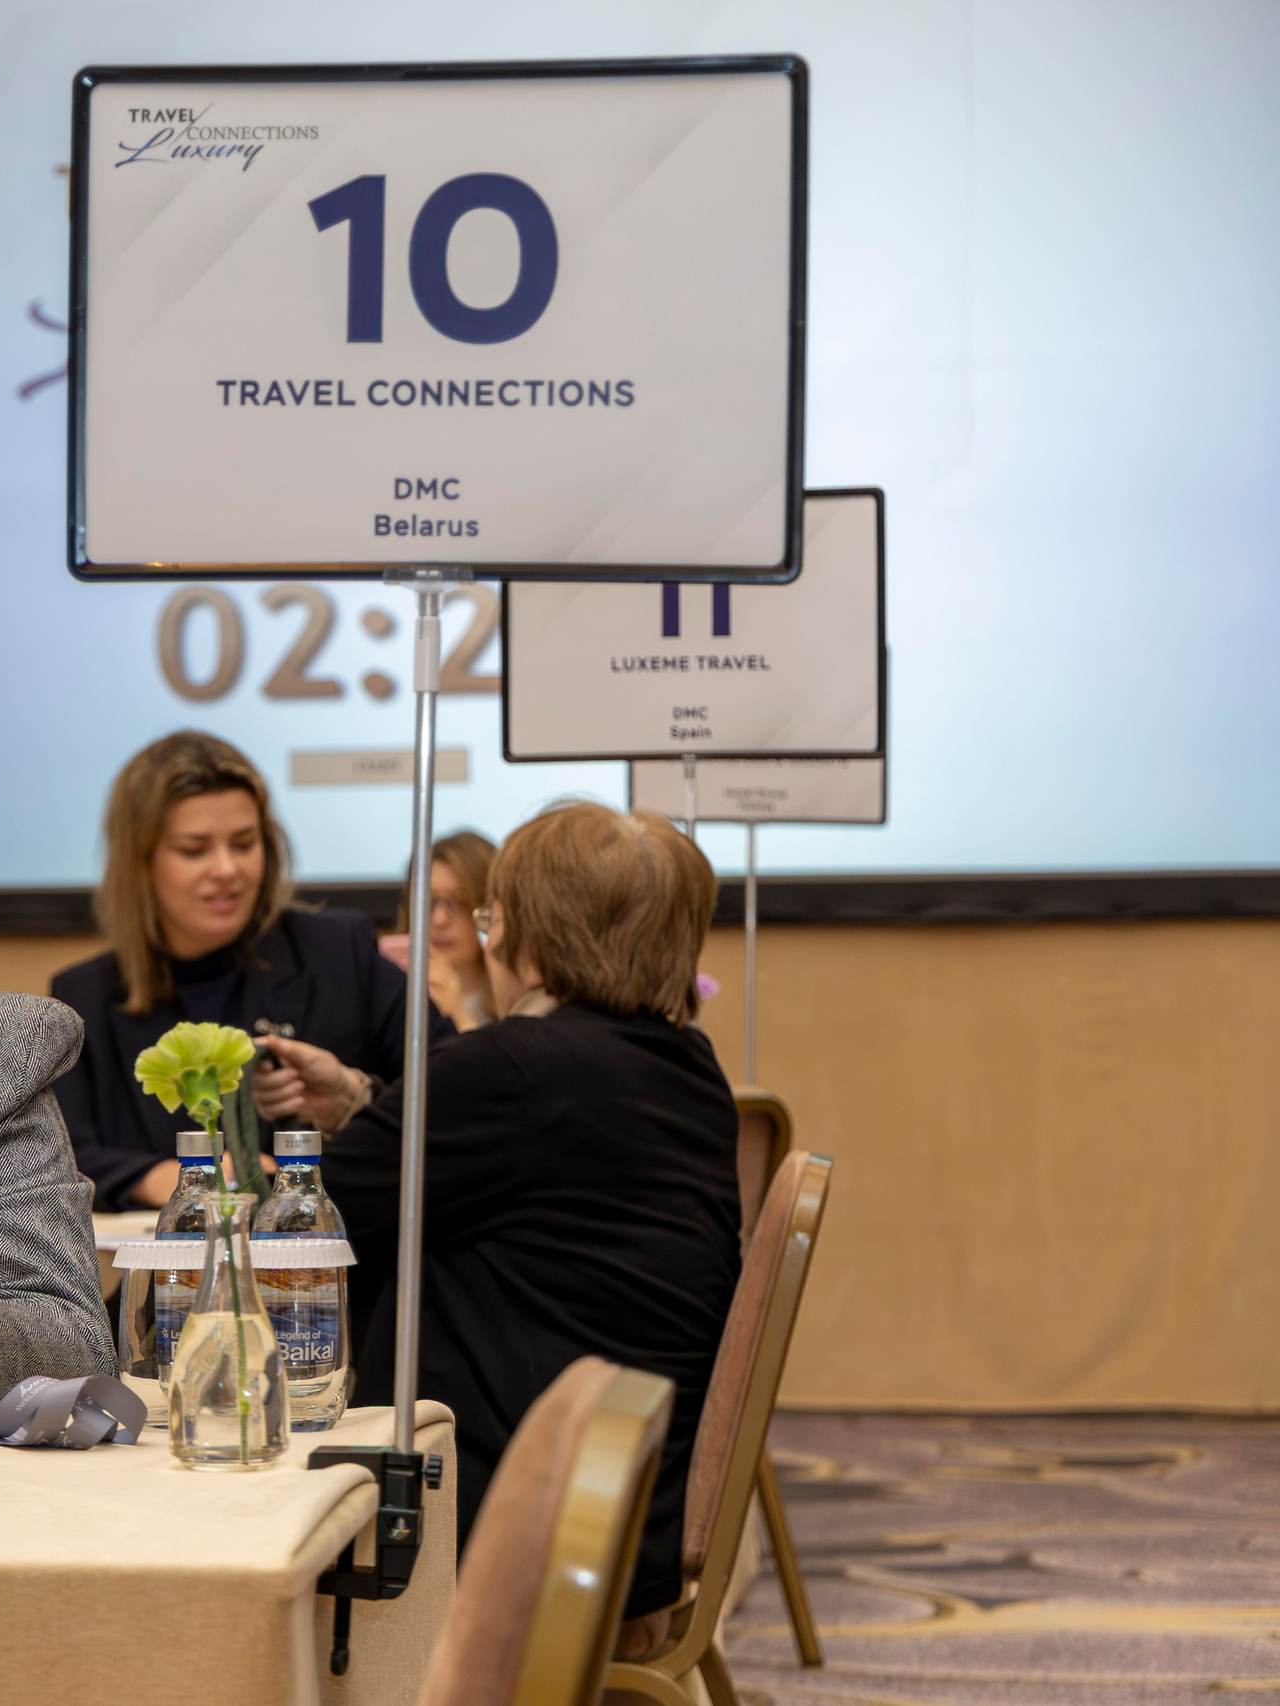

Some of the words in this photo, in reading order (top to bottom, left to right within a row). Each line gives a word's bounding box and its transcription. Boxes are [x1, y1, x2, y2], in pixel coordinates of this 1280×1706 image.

[128, 107, 197, 124] TRAVEL
[186, 125, 320, 141] CONNECTIONS
[114, 126, 265, 173] Luxury
[307, 171, 560, 345] 10
[216, 379, 356, 407] TRAVEL
[366, 378, 636, 408] CONNECTIONS
[393, 477, 461, 501] DMC
[373, 513, 480, 538] Belarus
[609, 655, 690, 674] LUXEME
[696, 654, 772, 672] TRAVEL
[671, 705, 710, 722] DMC
[669, 725, 713, 741] Spain
[275, 1330, 311, 1342] Legend
[312, 1330, 322, 1341] of
